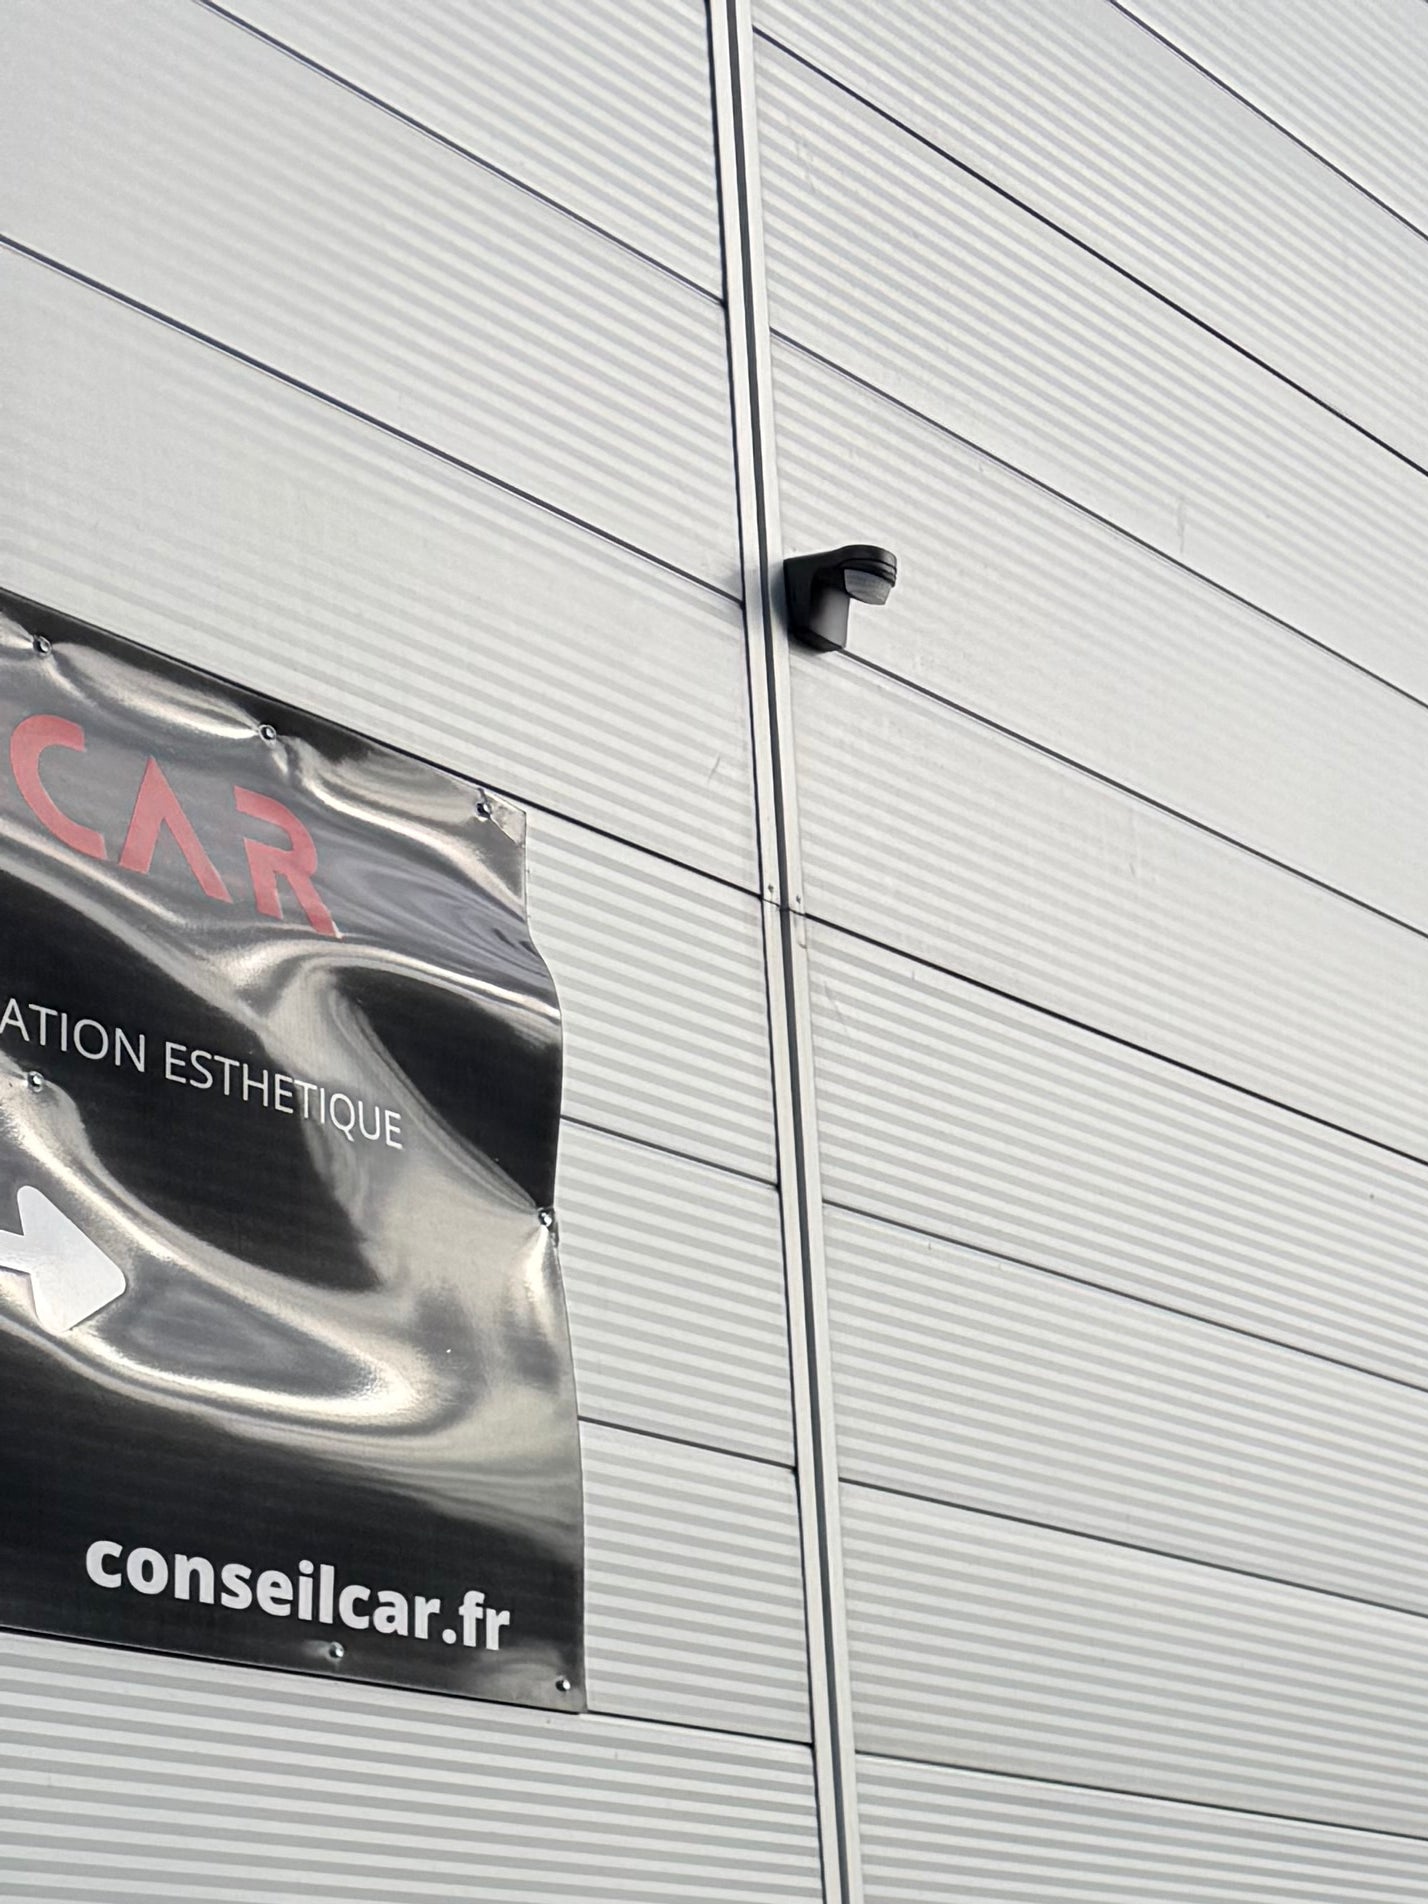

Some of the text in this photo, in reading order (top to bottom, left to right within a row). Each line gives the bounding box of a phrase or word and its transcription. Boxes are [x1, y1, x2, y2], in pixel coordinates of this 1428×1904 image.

[10, 714, 342, 939] CAR
[164, 1040, 404, 1150] ESTHETIQUE
[86, 1539, 510, 1651] conseilcar.fr
